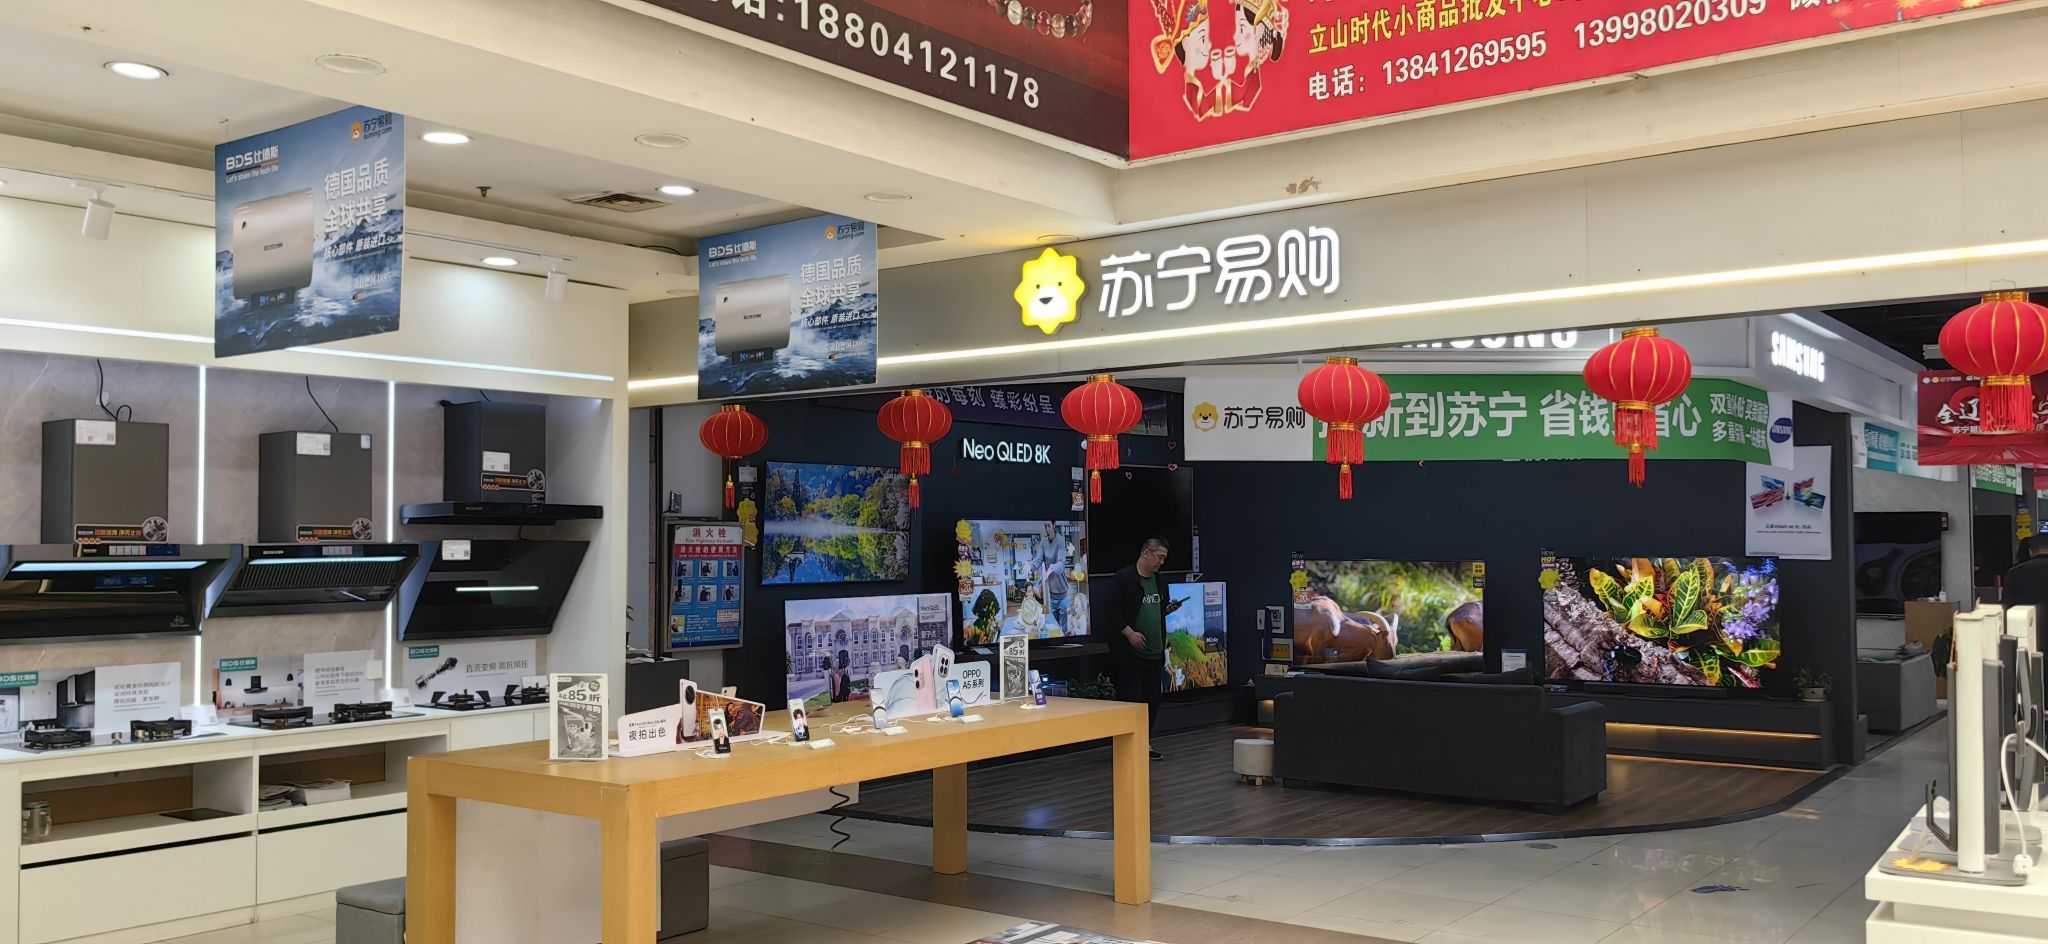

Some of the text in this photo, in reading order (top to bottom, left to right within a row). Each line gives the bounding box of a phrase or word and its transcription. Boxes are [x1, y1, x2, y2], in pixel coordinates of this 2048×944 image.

[1308, 0, 1551, 54] 立山时代小商品批发
[1382, 30, 1547, 85] 13841269595
[1573, 0, 1766, 49] 13998020309
[324, 157, 389, 200] 德国品质
[323, 194, 388, 234] 全球共享
[801, 254, 862, 284] 德国品质
[1099, 225, 1340, 318] 苏宁易购
[801, 281, 861, 310] 全球共享
[801, 315, 829, 329] 核心部件
[1771, 330, 1825, 383] SAMSUNG
[990, 389, 1056, 414] 臻彩纷呈
[1319, 391, 1528, 438] 新到苏宁
[1224, 406, 1306, 429] 苏宁易购
[963, 438, 1051, 464] Neo QLED 8K
[692, 527, 727, 538] 消火栓
[962, 668, 981, 679] OPPO
[629, 727, 666, 741] 夜拍出色
